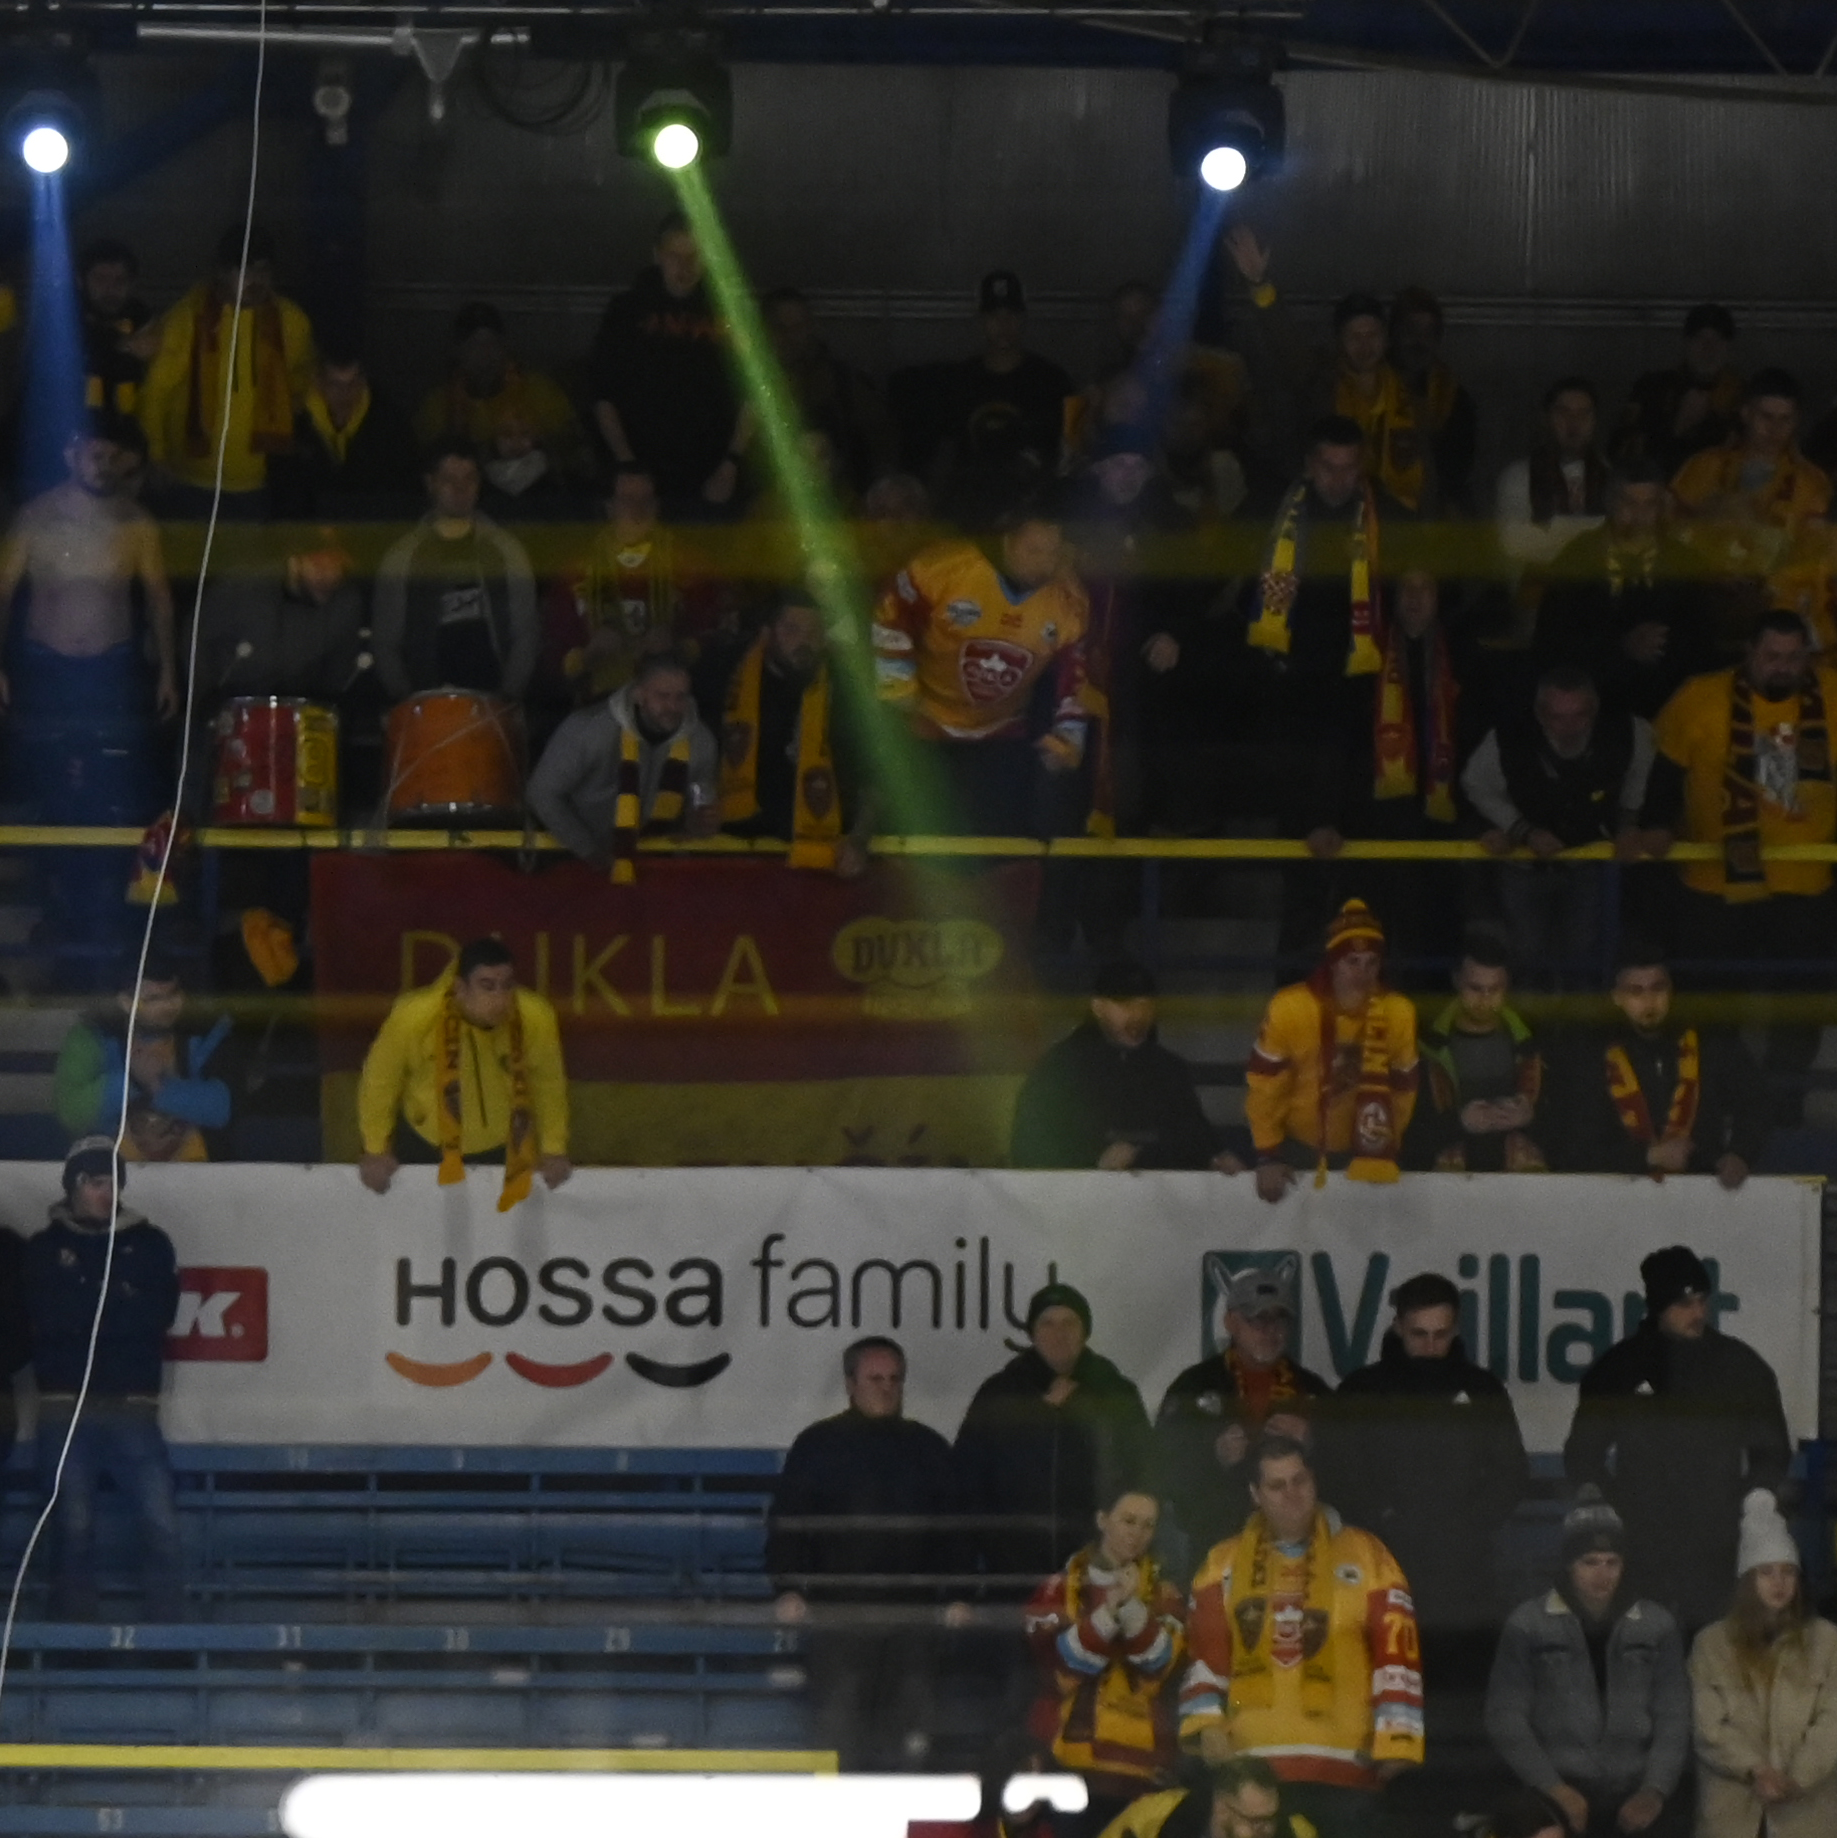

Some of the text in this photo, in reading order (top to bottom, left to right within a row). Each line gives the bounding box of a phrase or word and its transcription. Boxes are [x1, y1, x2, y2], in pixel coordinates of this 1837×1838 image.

[399, 929, 781, 1018] DKLA
[395, 1233, 1061, 1353] Hossa family
[1311, 1251, 1740, 1384] Villat
